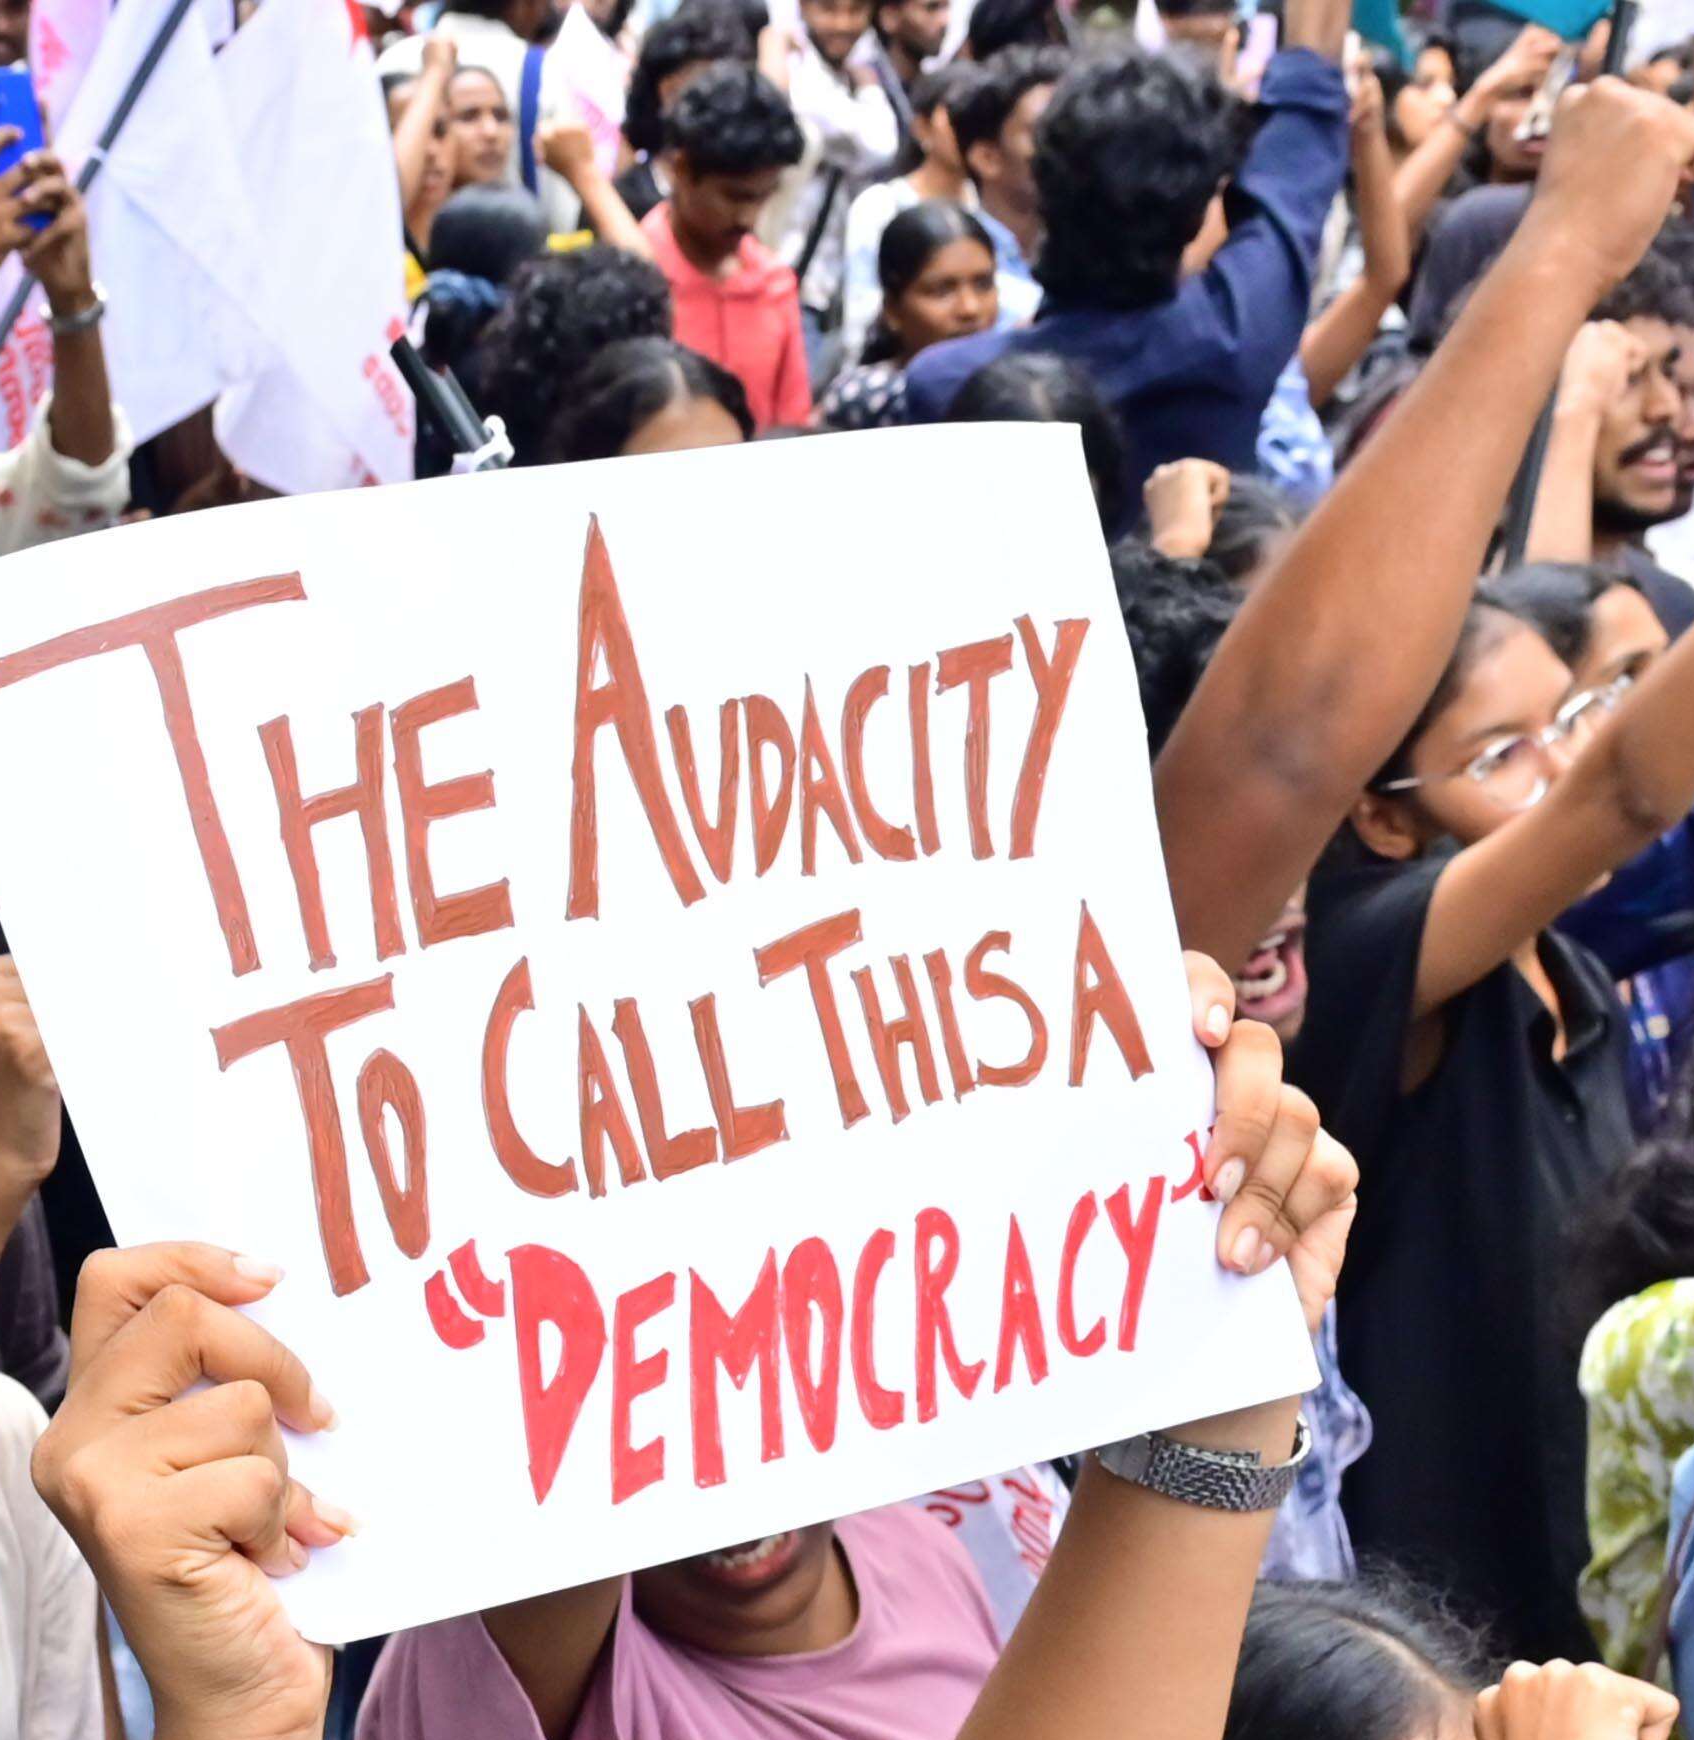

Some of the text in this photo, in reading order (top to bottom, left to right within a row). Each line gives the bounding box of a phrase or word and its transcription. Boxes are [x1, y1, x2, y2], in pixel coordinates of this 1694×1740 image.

[564, 512, 1091, 919] AUDACITY
[210, 899, 1155, 1298] TO CALL THIS A
